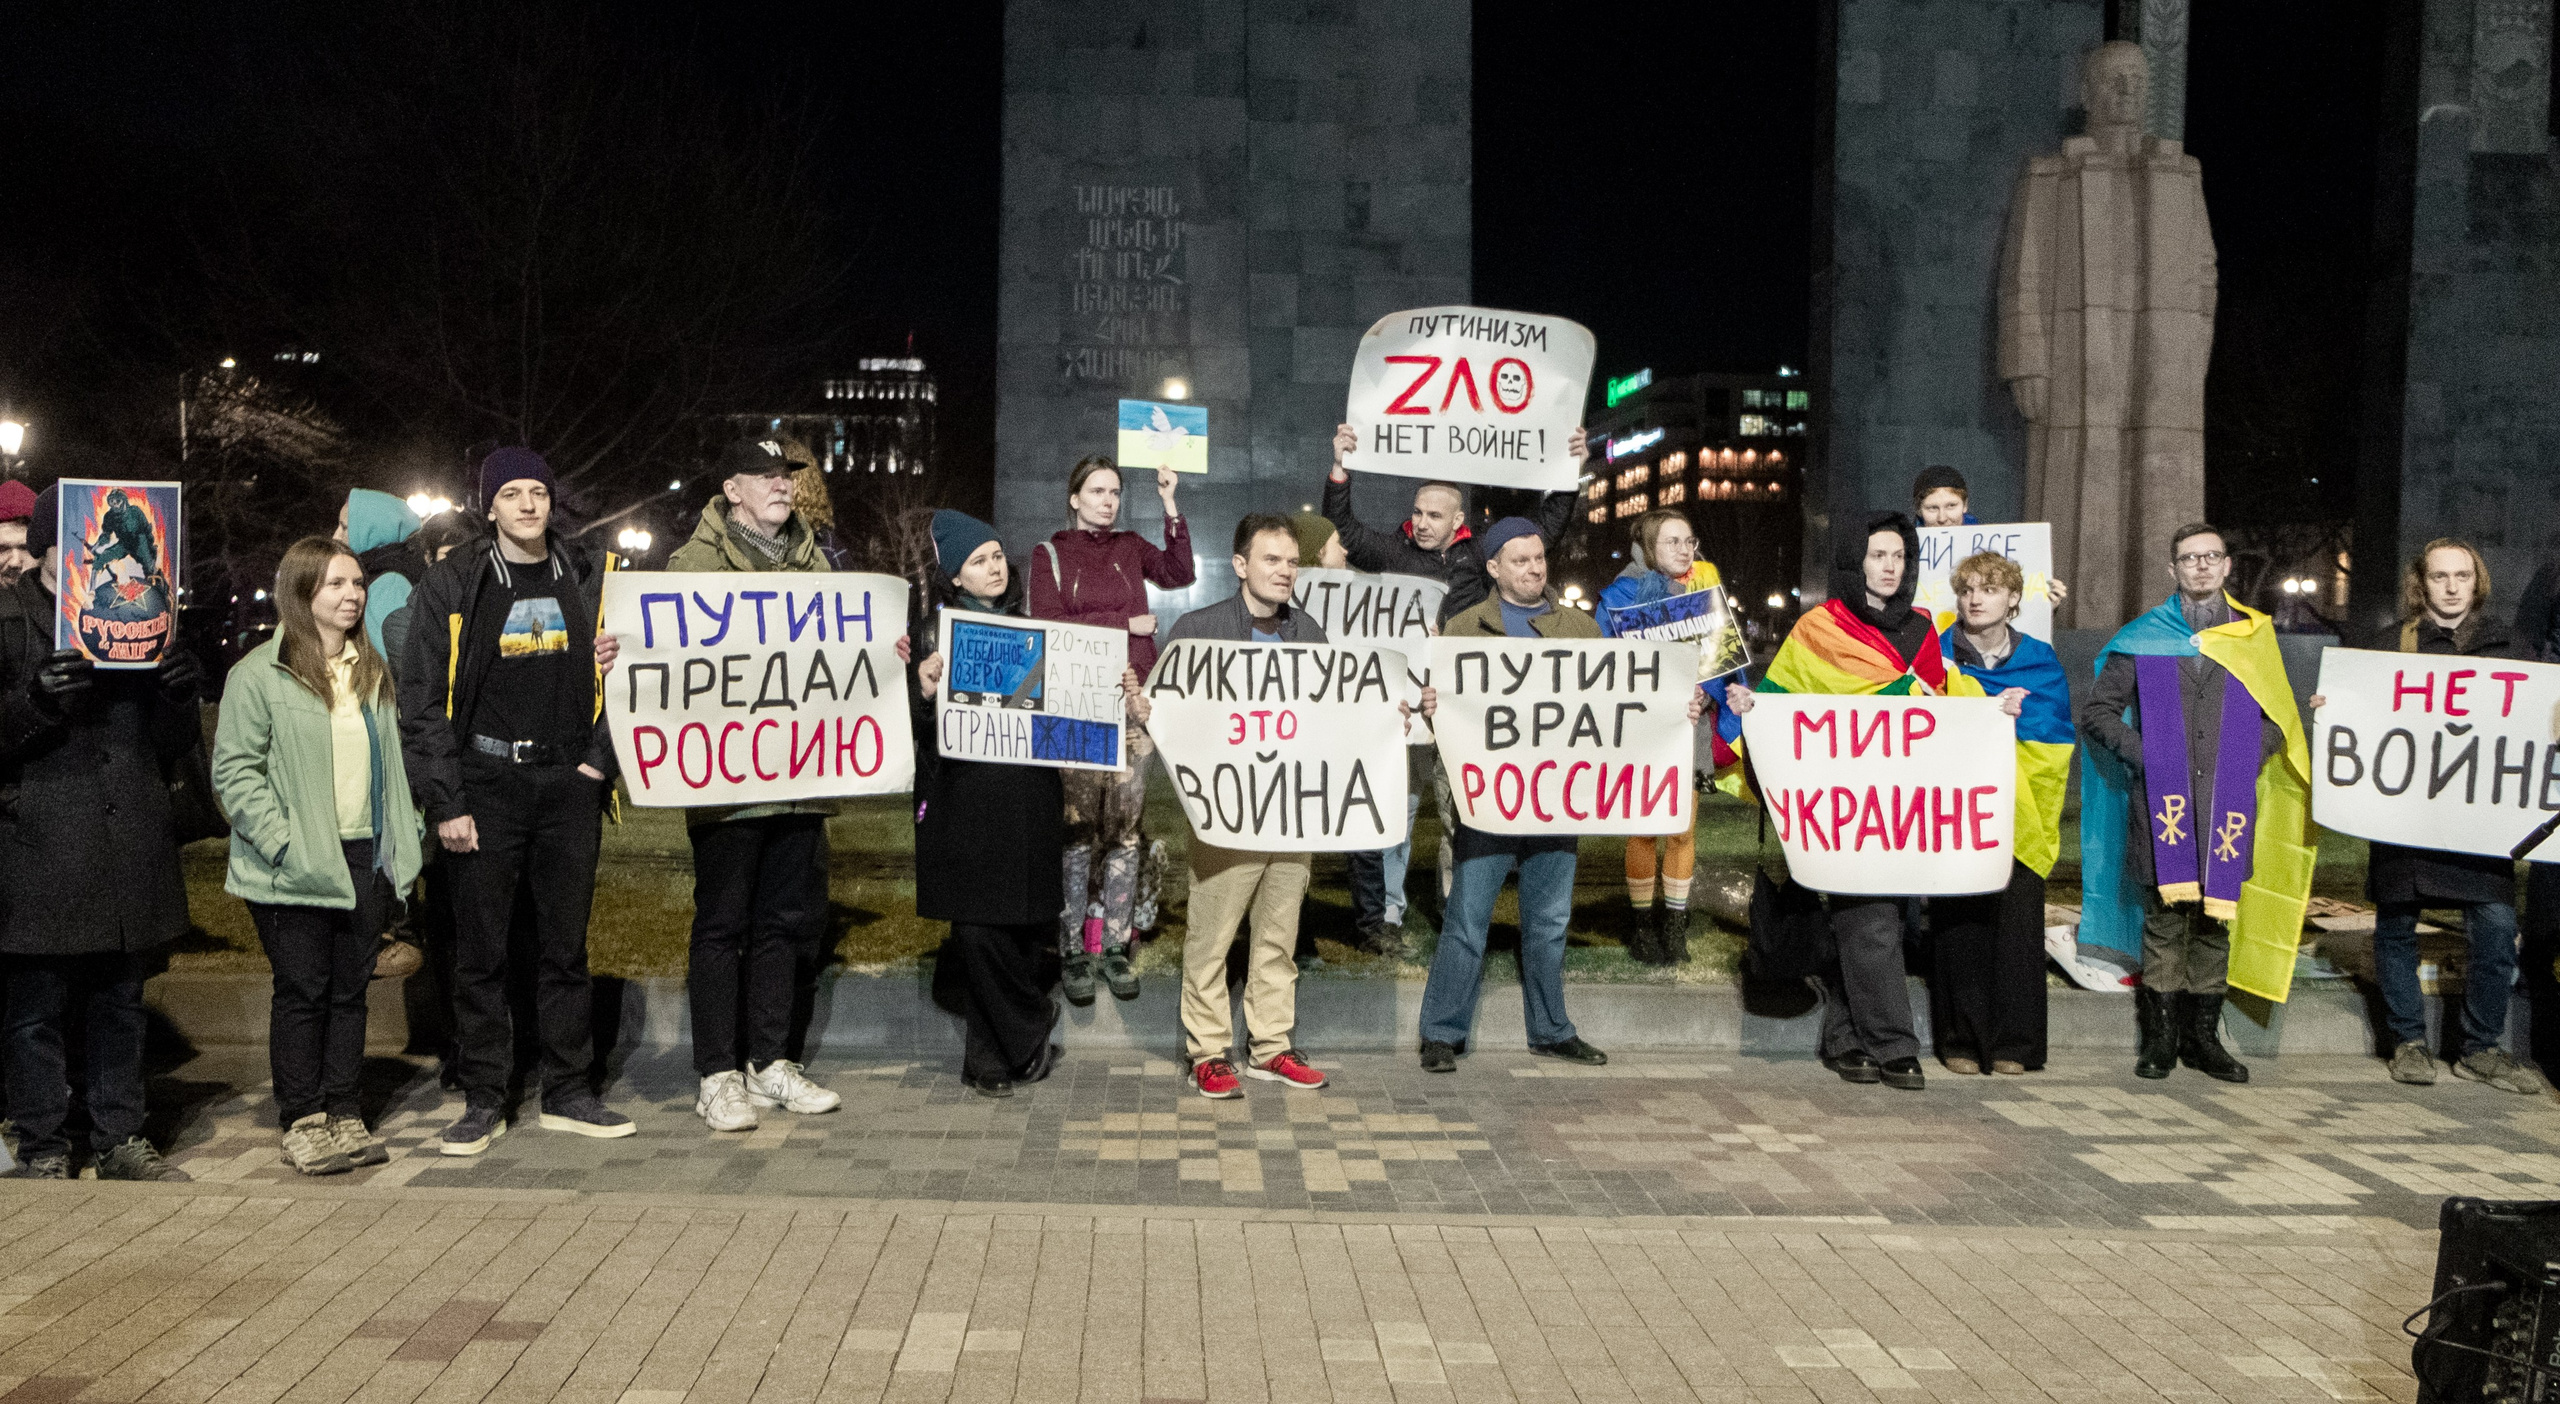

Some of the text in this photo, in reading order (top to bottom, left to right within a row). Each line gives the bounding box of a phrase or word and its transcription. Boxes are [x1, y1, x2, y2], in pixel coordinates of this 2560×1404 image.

[1409, 315, 1547, 352] ПУТИНИЗМ
[1374, 424, 1545, 463] НЕТ ВОЙНЕ!
[640, 591, 874, 649] ПУТИН
[955, 639, 1024, 666] ЛЕБЕДИНОЕ
[955, 662, 1003, 688] ОЗЕРО
[1049, 663, 1109, 688] А ГДЕ
[1151, 645, 1388, 703] ДИКТАТУРА
[1454, 650, 1661, 697] ПУТИН
[629, 648, 878, 714] ПРЕДАЛ
[2393, 669, 2529, 717] НЕТ
[633, 715, 884, 789] РОССИЮ
[943, 709, 1029, 759] СТРАНА
[1228, 709, 1298, 746] ЭТО
[1485, 702, 1648, 752] ВРАГ
[1792, 707, 1936, 761] МИР
[2327, 721, 2560, 811] ВОЙНЕ
[1175, 751, 1386, 839] ВОЙНА
[1461, 760, 1680, 823] РОССИИ
[1766, 785, 2000, 854] УКРАИНЕ
